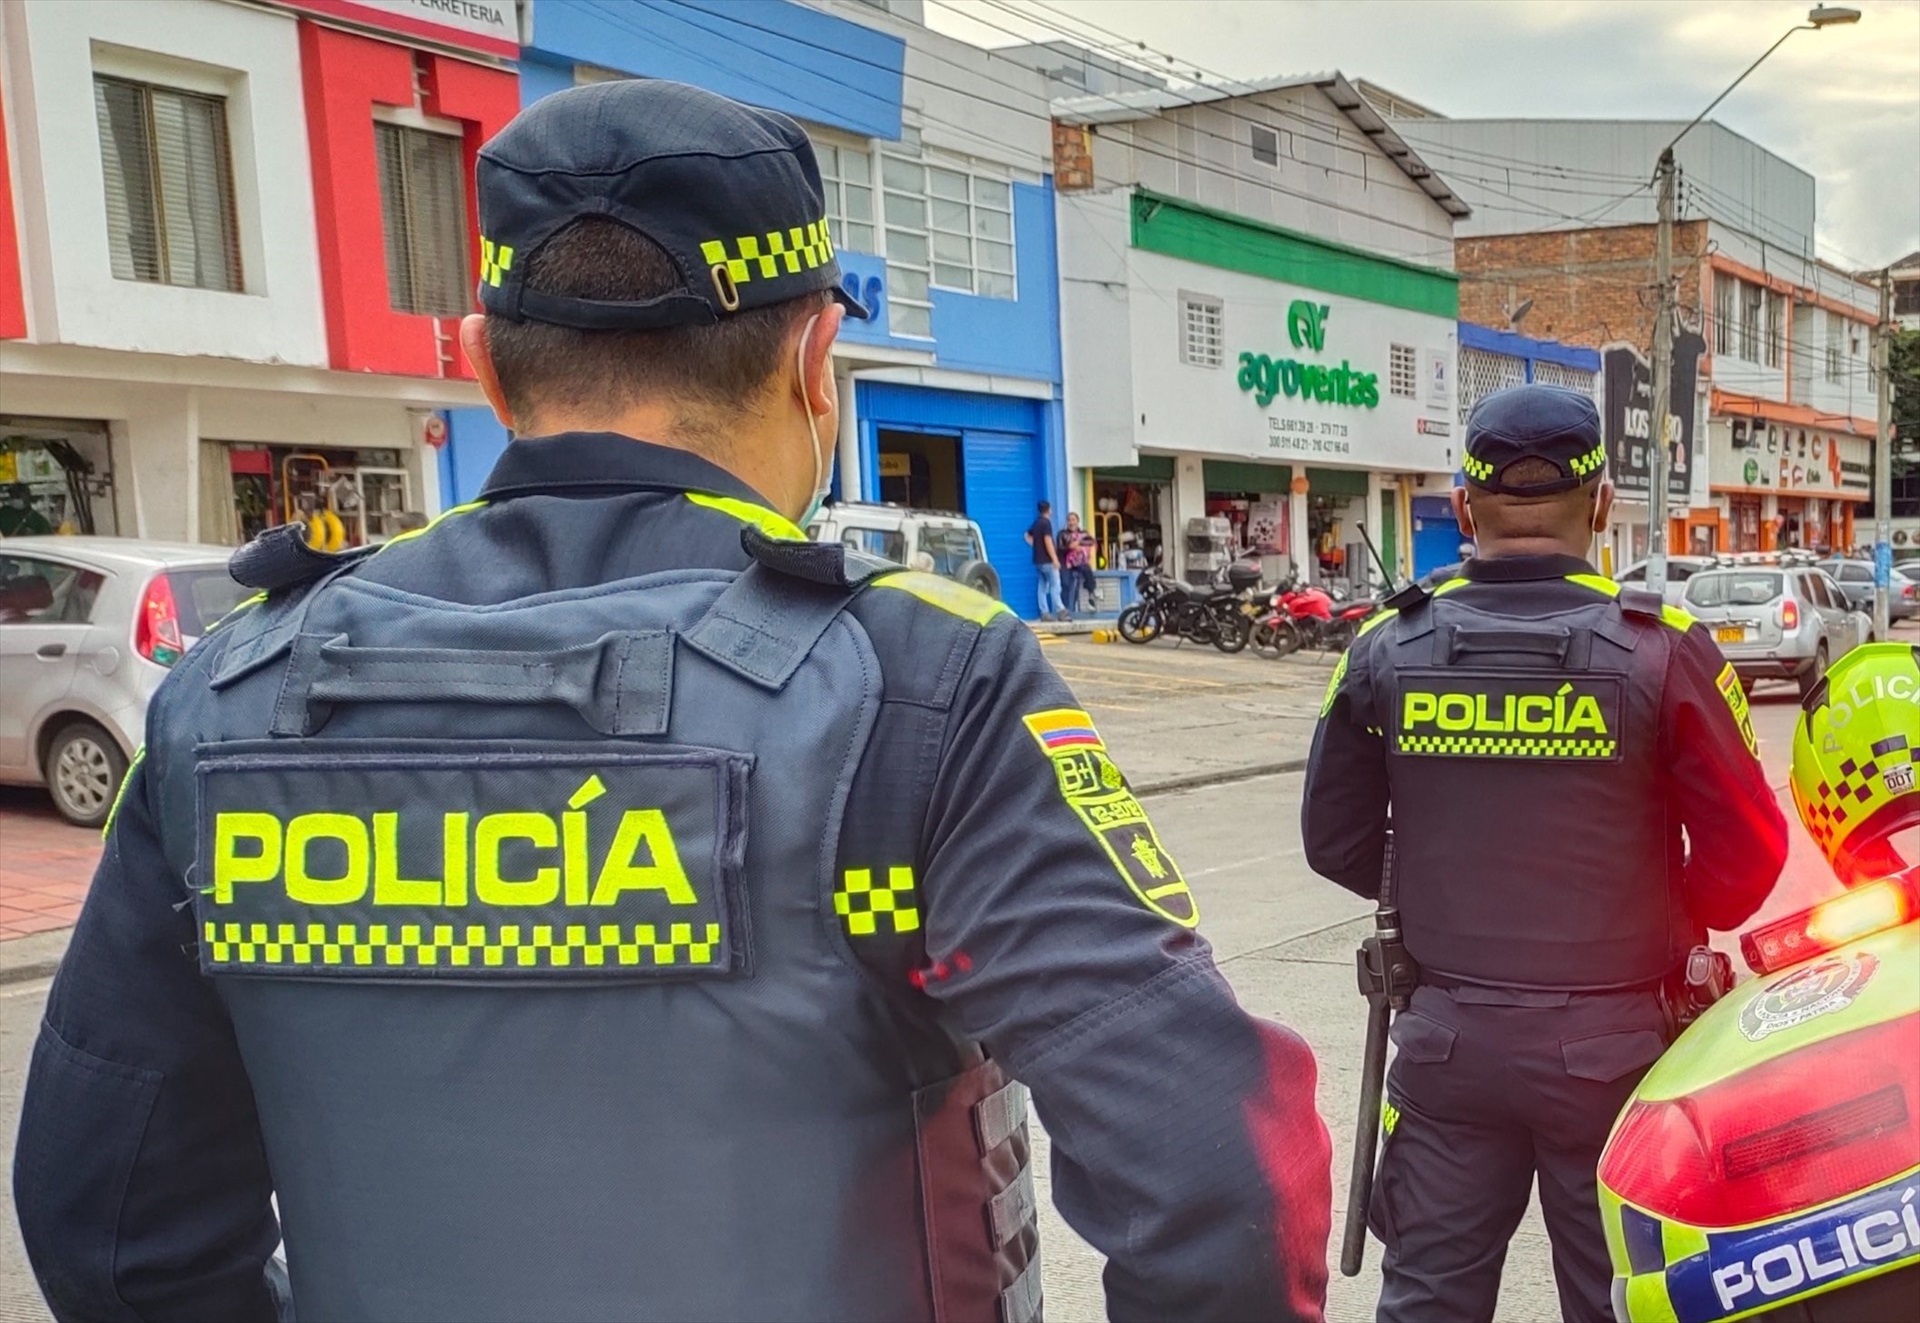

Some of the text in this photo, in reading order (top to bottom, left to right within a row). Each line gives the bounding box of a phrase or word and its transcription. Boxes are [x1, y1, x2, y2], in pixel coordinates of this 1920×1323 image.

[411, 0, 505, 26] RRETERIA
[1238, 352, 1380, 408] agroventas
[1624, 407, 1650, 440] LOS
[1403, 683, 1607, 734] POLICÍA
[1059, 757, 1090, 791] B+
[214, 775, 698, 906] POLICÍA
